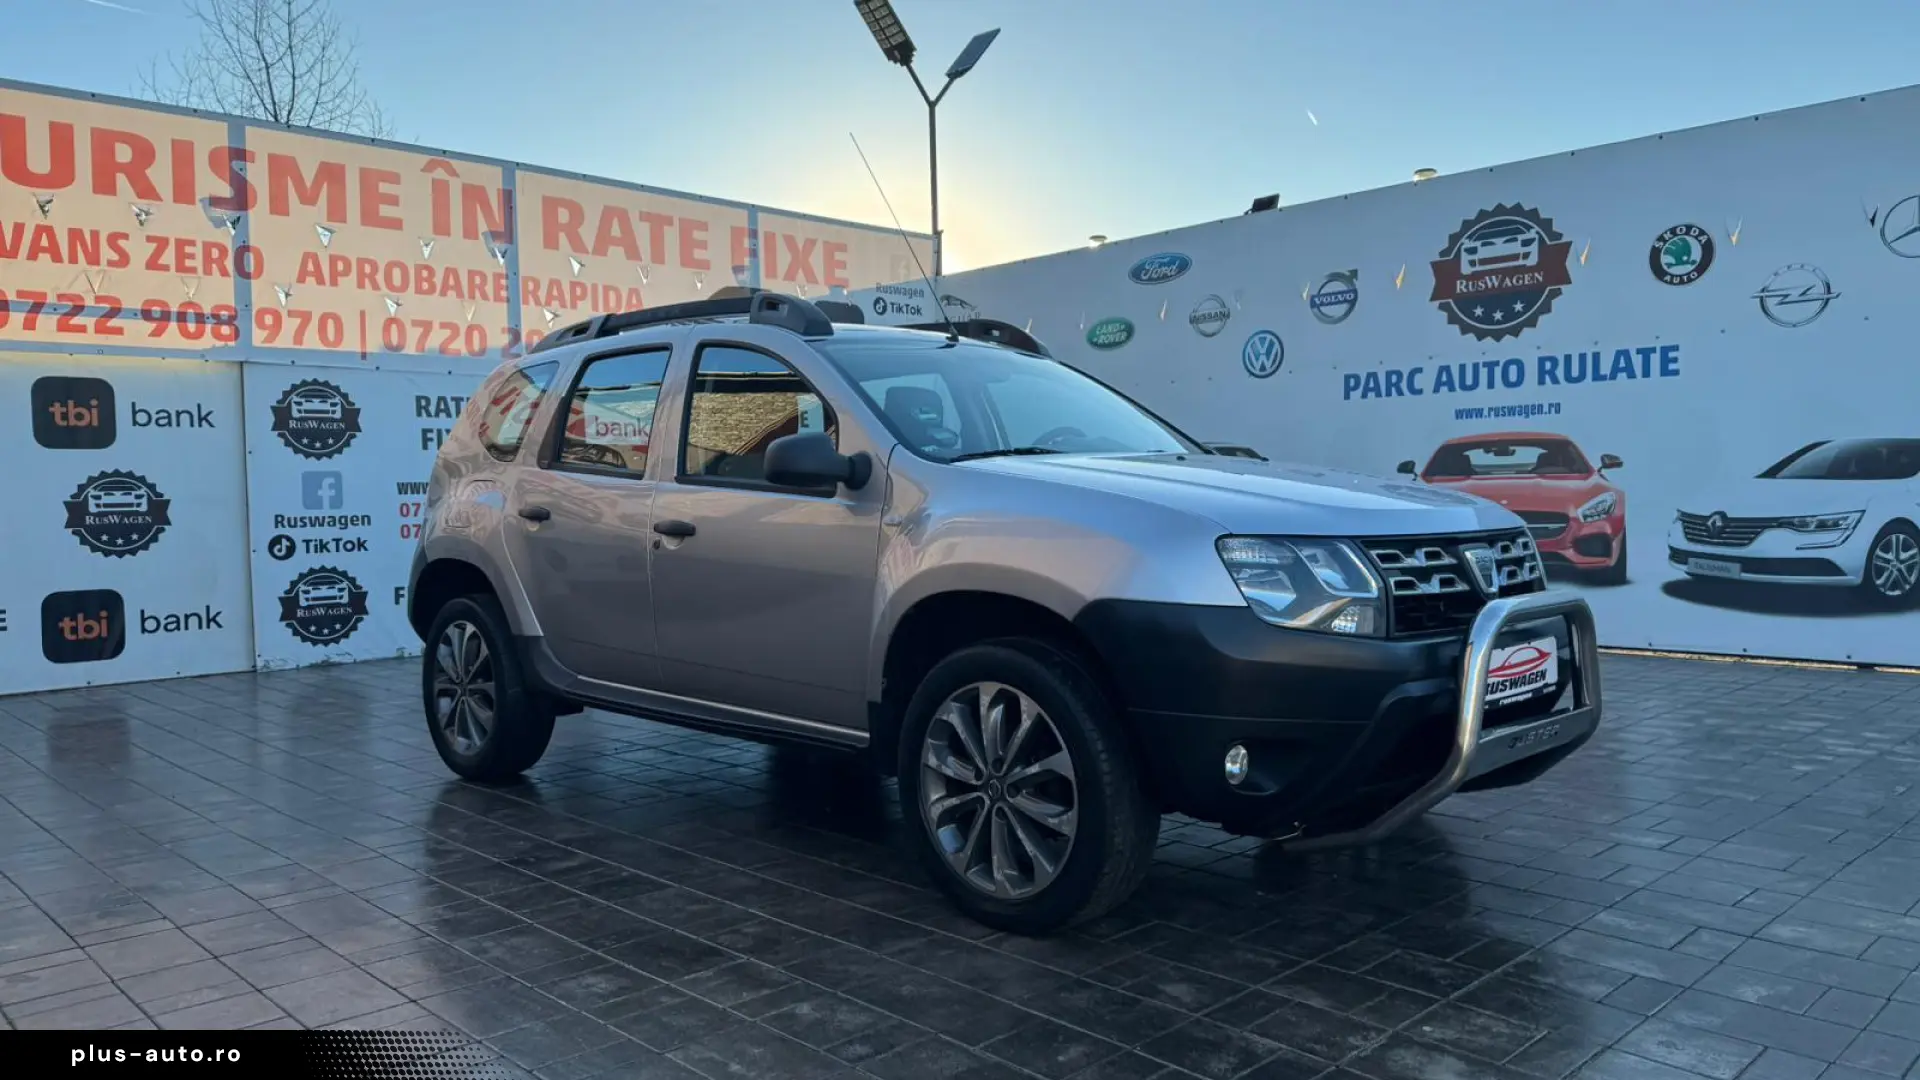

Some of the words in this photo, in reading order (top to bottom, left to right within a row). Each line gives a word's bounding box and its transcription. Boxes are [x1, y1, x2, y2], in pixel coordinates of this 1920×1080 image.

[420, 158, 514, 245] ÎN
[541, 194, 711, 271] RATE
[730, 226, 849, 289] FIXE
[0, 221, 131, 269] VANS
[145, 235, 264, 280] ZERO
[296, 251, 510, 304] APROBARE
[521, 276, 644, 314] RAPIDA
[1664, 271, 1698, 284] AUTO
[876, 282, 925, 299] Ruswagen
[1314, 291, 1355, 305] VOLVO
[890, 301, 922, 317] TikTok
[140, 299, 240, 343] 908
[254, 307, 344, 349] 970
[382, 317, 487, 358] 0720
[1343, 367, 1423, 400] PARC
[1432, 358, 1526, 394] AUTO
[1537, 344, 1681, 386] RULATE
[49, 400, 99, 427] tbi
[131, 402, 215, 428] bank
[415, 395, 471, 418] RAT
[1454, 401, 1562, 421] www.ruswagen.ro
[421, 428, 451, 450] FI
[274, 514, 371, 530] Ruswagen
[302, 537, 369, 553] TikTok
[58, 611, 109, 641] tbi
[140, 605, 223, 634] bank
